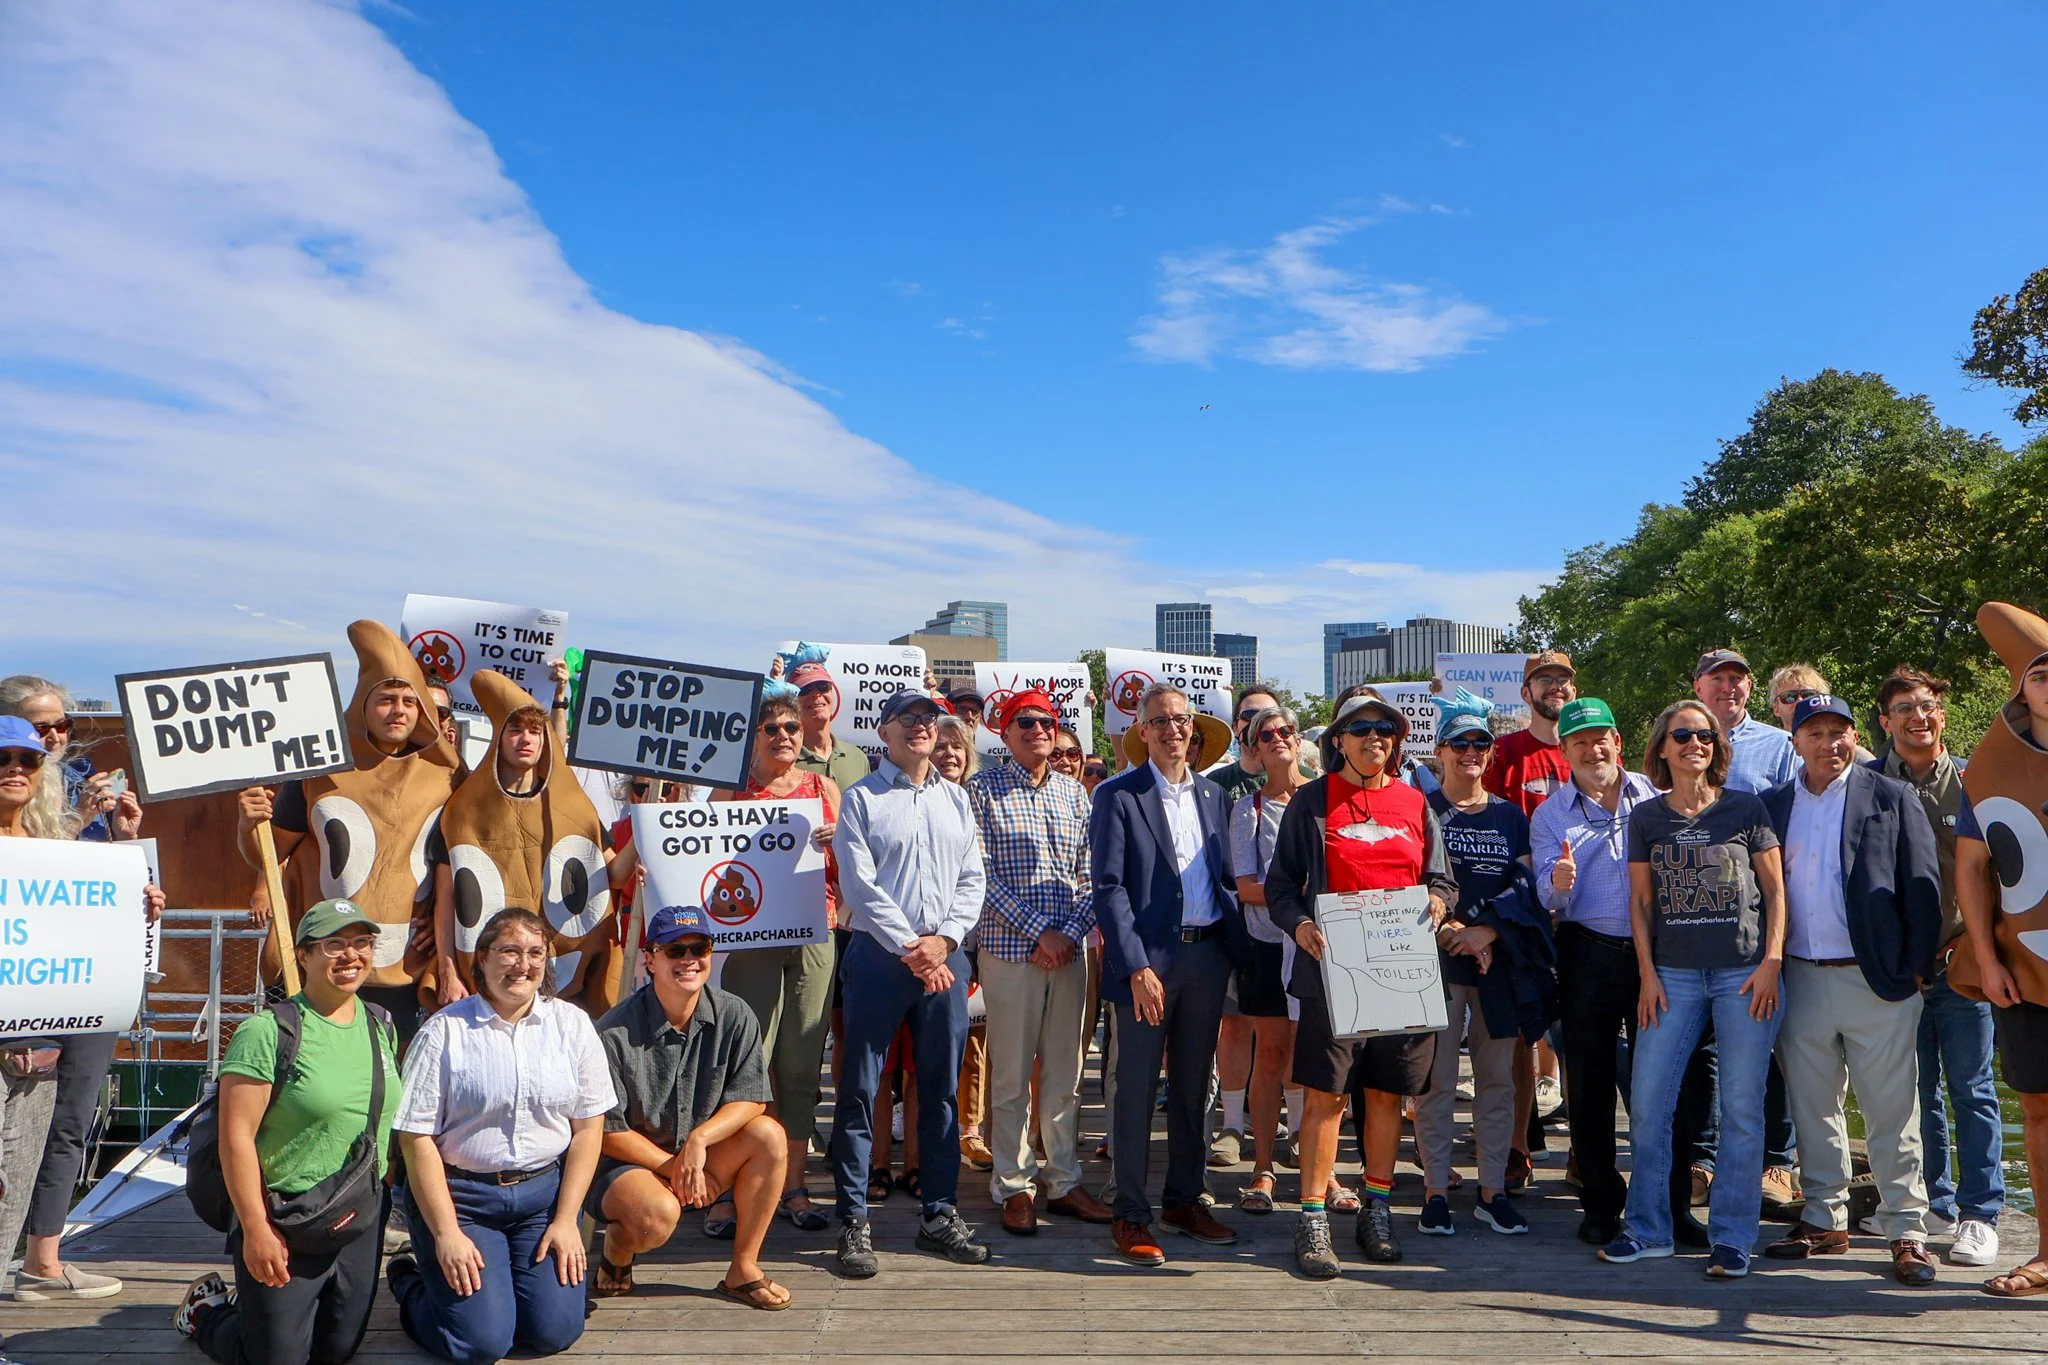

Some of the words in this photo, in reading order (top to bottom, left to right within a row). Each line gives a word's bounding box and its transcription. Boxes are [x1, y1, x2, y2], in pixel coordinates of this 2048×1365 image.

[474, 622, 507, 640] IT'S
[513, 628, 555, 646] TIME
[480, 643, 504, 660] TO
[510, 648, 545, 664] CUT
[493, 665, 526, 681] THE
[843, 662, 869, 676] NO
[875, 664, 921, 677] MORE
[1162, 663, 1187, 674] IT'S
[1191, 665, 1223, 676] TIME
[1445, 670, 1485, 682] CLEAN
[1489, 670, 1524, 683] WATE
[611, 669, 704, 704] STOP
[859, 681, 906, 694] POOP
[1025, 678, 1045, 688] NO
[1167, 677, 1187, 689] TO
[1191, 678, 1218, 690] CUT
[144, 671, 290, 721] DON'T
[1048, 693, 1073, 703] OOP
[1187, 694, 1205, 705] HE
[1396, 693, 1415, 703] IT'S
[1419, 694, 1432, 703] TI
[1483, 686, 1494, 698] IS
[453, 702, 483, 713] ECRA
[855, 698, 873, 711] IN
[1400, 707, 1415, 717] TO
[1419, 707, 1435, 717] CU
[587, 696, 747, 743] DUMPING
[854, 716, 881, 730] RIV
[1411, 720, 1431, 730] THE
[154, 710, 276, 757] DUMP
[272, 729, 340, 772] ME!
[636, 736, 718, 774] ME!
[987, 747, 1009, 755] #CUT
[659, 809, 719, 828] CSOs
[727, 807, 789, 826] HAVE
[662, 835, 713, 856] GOT
[720, 834, 751, 853] TO
[759, 832, 796, 852] GO
[1442, 831, 1475, 843] LEAN
[1448, 841, 1509, 856] CHARLES
[1650, 843, 1707, 871] CUT
[1658, 868, 1698, 888] THE
[18, 879, 117, 907] WATER
[1658, 885, 1737, 914] CRAP
[1341, 894, 1393, 911] STOP
[1364, 907, 1421, 919] TREATING
[4, 918, 28, 945] IS
[1367, 928, 1412, 940] RIVERS
[1370, 960, 1435, 979] TOILETS!
